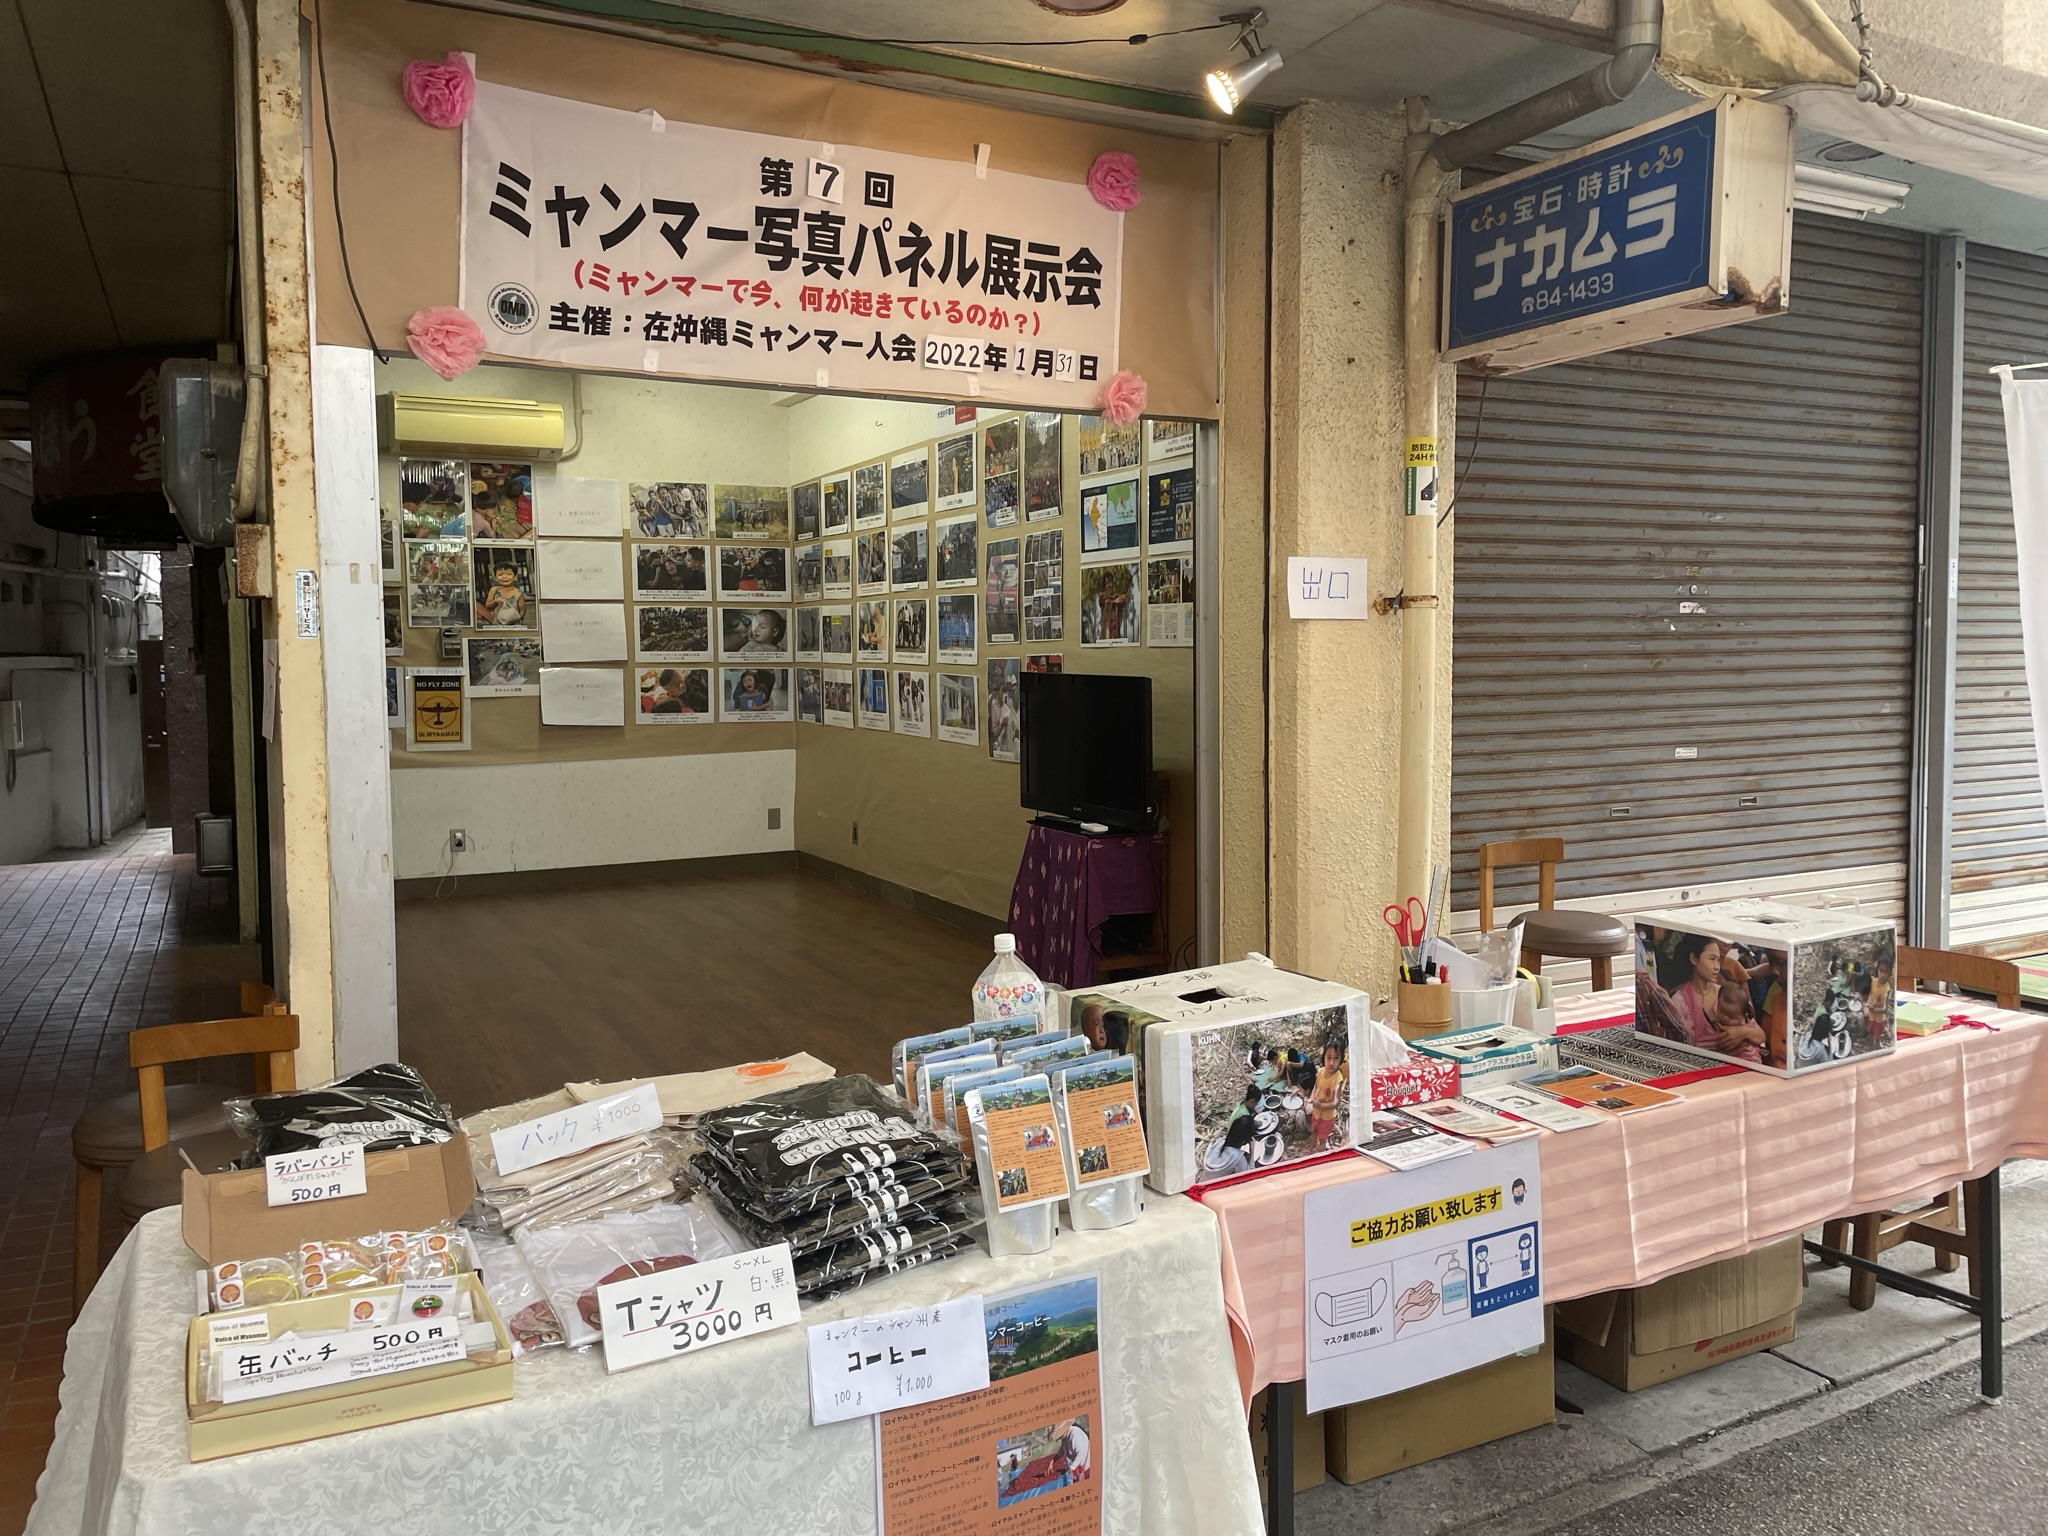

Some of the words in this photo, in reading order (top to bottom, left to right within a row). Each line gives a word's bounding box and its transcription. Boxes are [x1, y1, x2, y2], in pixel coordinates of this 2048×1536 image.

[759, 157, 894, 208] 第7回
[1513, 164, 1632, 225] 宝石・時計
[489, 161, 1102, 308] ミャンマー写真パネル展示会
[1473, 184, 1677, 300] ナカムラ
[500, 300, 526, 318] OMA
[1303, 567, 1349, 600] 出口
[1386, 1083, 1419, 1097] Bouquet
[274, 1150, 355, 1175] ラバーバンド
[1351, 1189, 1502, 1244] ご協力お願い致します
[615, 1279, 724, 1332] Tシャツ
[1323, 1326, 1383, 1346] マスク着用のお願い
[237, 1342, 338, 1377] 缶バッチ
[848, 1346, 927, 1373] コーヒー
